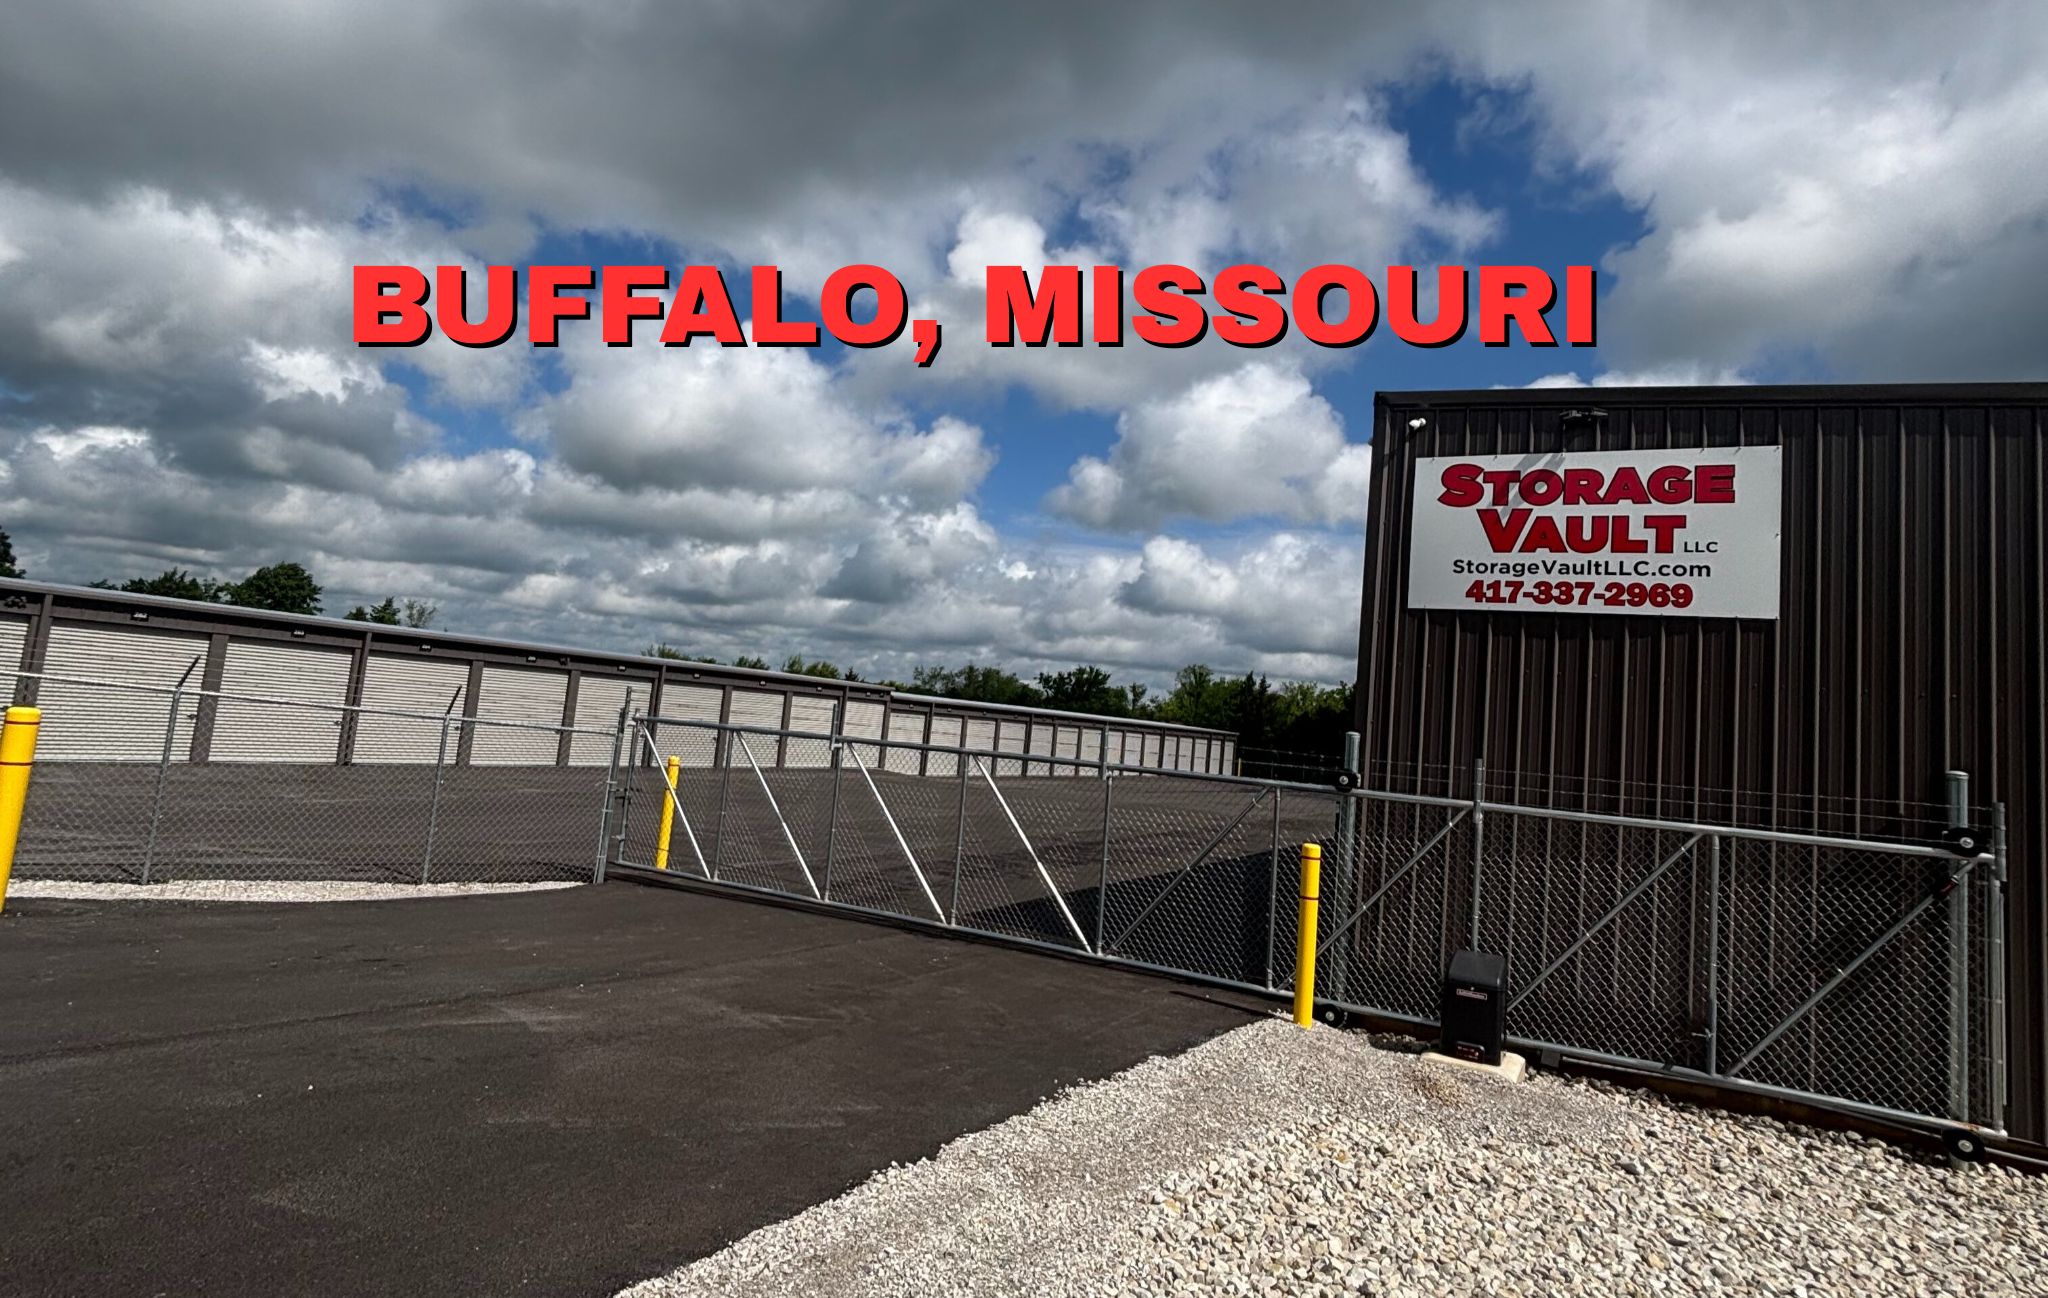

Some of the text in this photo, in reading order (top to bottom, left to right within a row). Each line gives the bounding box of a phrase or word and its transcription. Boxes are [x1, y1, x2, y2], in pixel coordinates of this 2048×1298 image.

[1436, 463, 1736, 508] STORAGE
[1476, 508, 1719, 554] VAULT LLC
[1452, 558, 1712, 579] StorageVaultLLC.com
[1465, 579, 1694, 608] 417-337-2969
